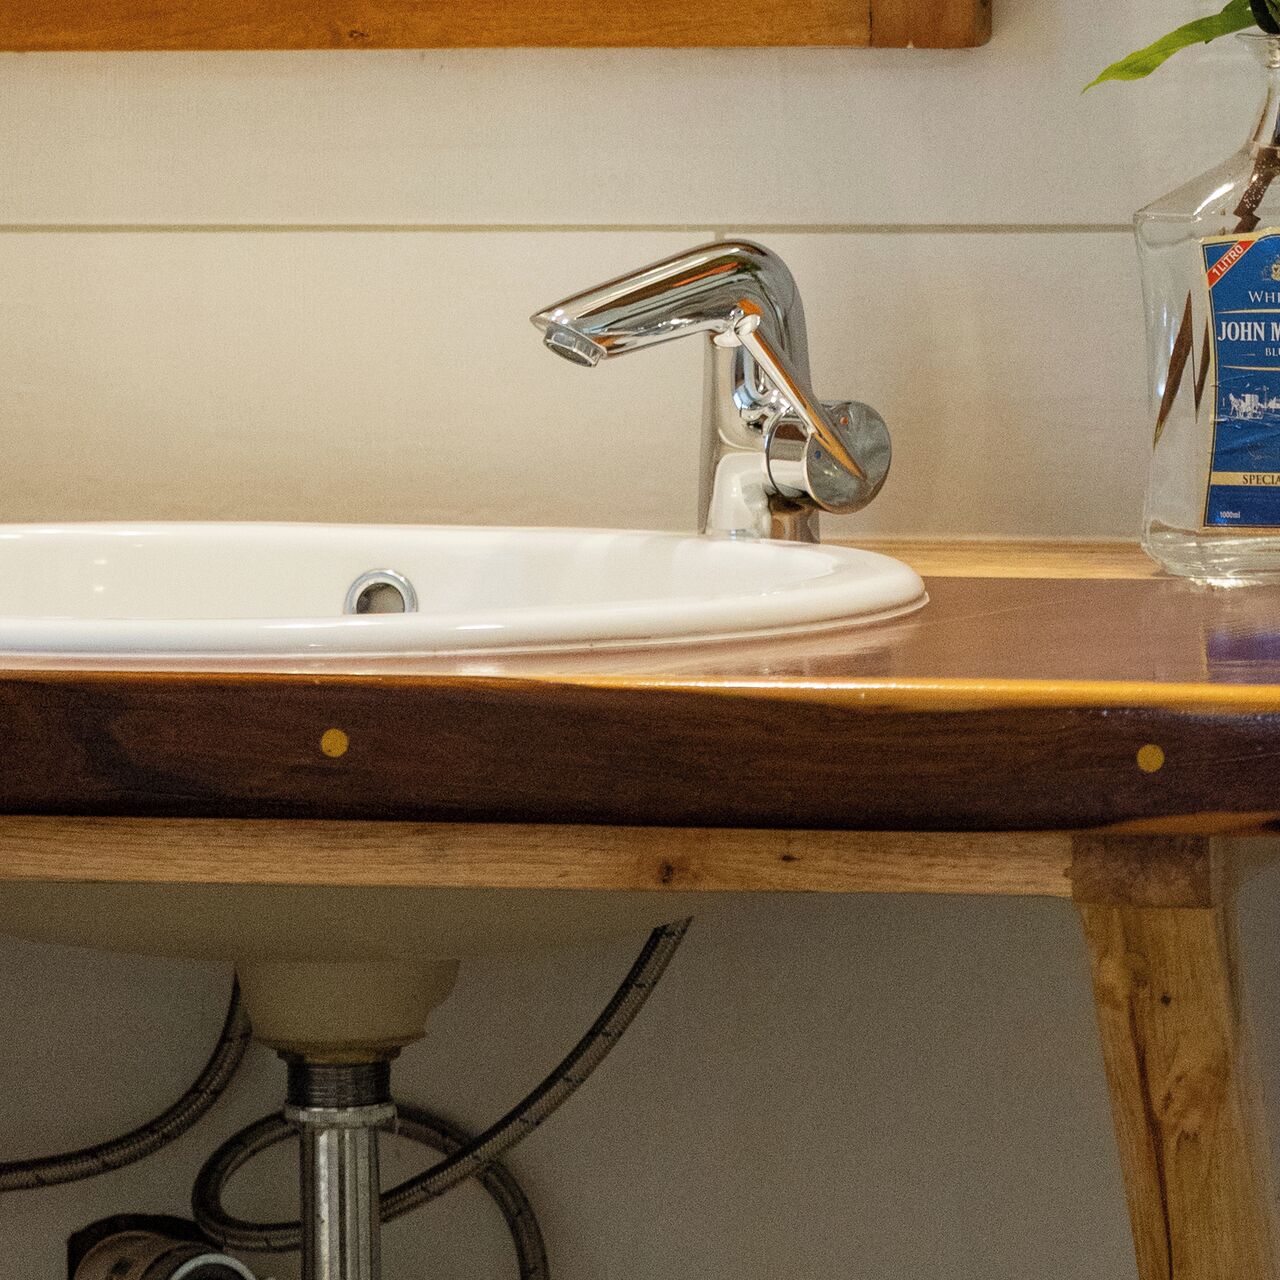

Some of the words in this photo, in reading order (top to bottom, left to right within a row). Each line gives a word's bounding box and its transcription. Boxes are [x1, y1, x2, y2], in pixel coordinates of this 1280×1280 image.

[1212, 268, 1221, 277] 1
[1219, 245, 1244, 271] LITRO
[1218, 322, 1266, 341] JOHN
[1219, 511, 1240, 519] 1000ml
